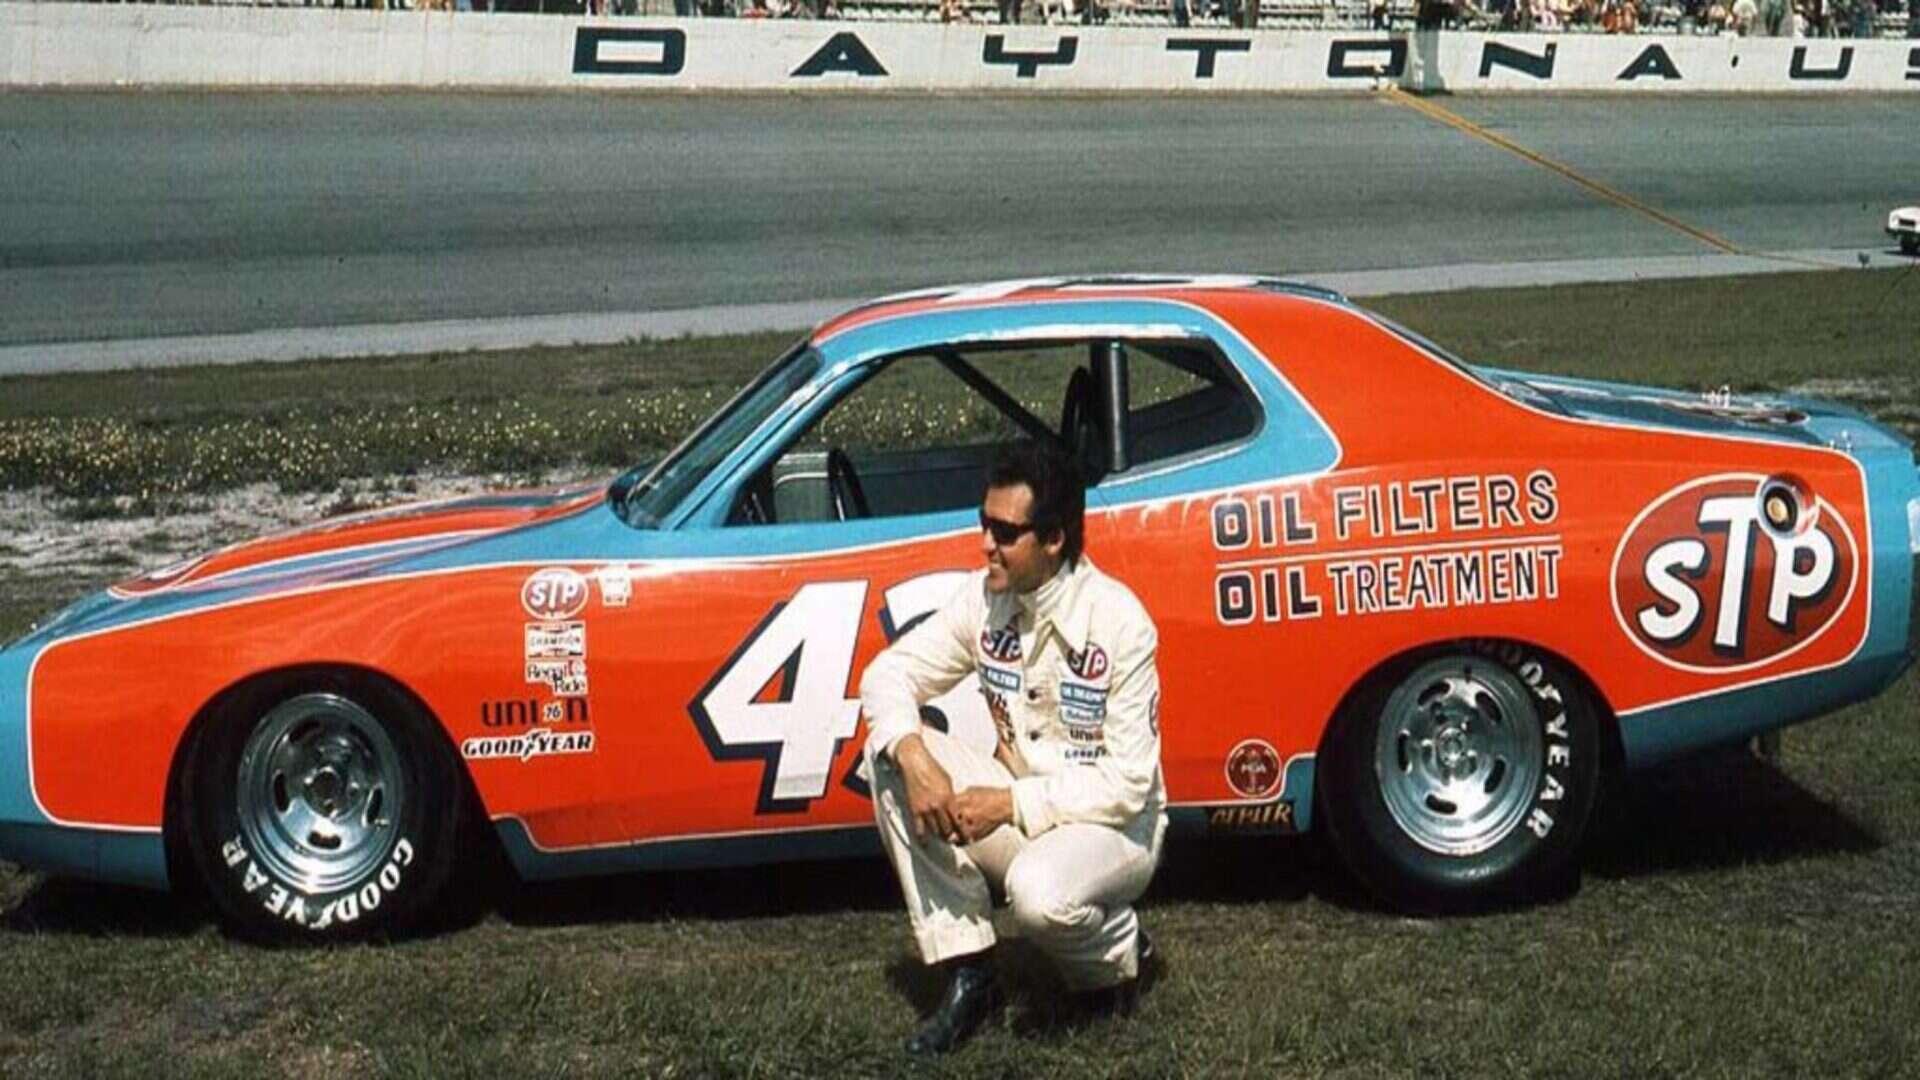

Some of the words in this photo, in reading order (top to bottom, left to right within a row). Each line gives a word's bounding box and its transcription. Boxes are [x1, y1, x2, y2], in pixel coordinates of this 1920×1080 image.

[573, 26, 1683, 80] DAYTONA
[1788, 46, 1920, 80] U
[1212, 492, 1317, 550] OIL
[1334, 470, 1558, 539] FILTERS
[529, 575, 579, 610] STP
[1216, 562, 1322, 625] OIL
[1328, 544, 1563, 616] TREATMENT
[1638, 494, 1838, 656] STP
[463, 732, 592, 758] GOODYEAR
[1466, 640, 1571, 838] OODYEAR
[222, 835, 414, 929] GOODYEAR
